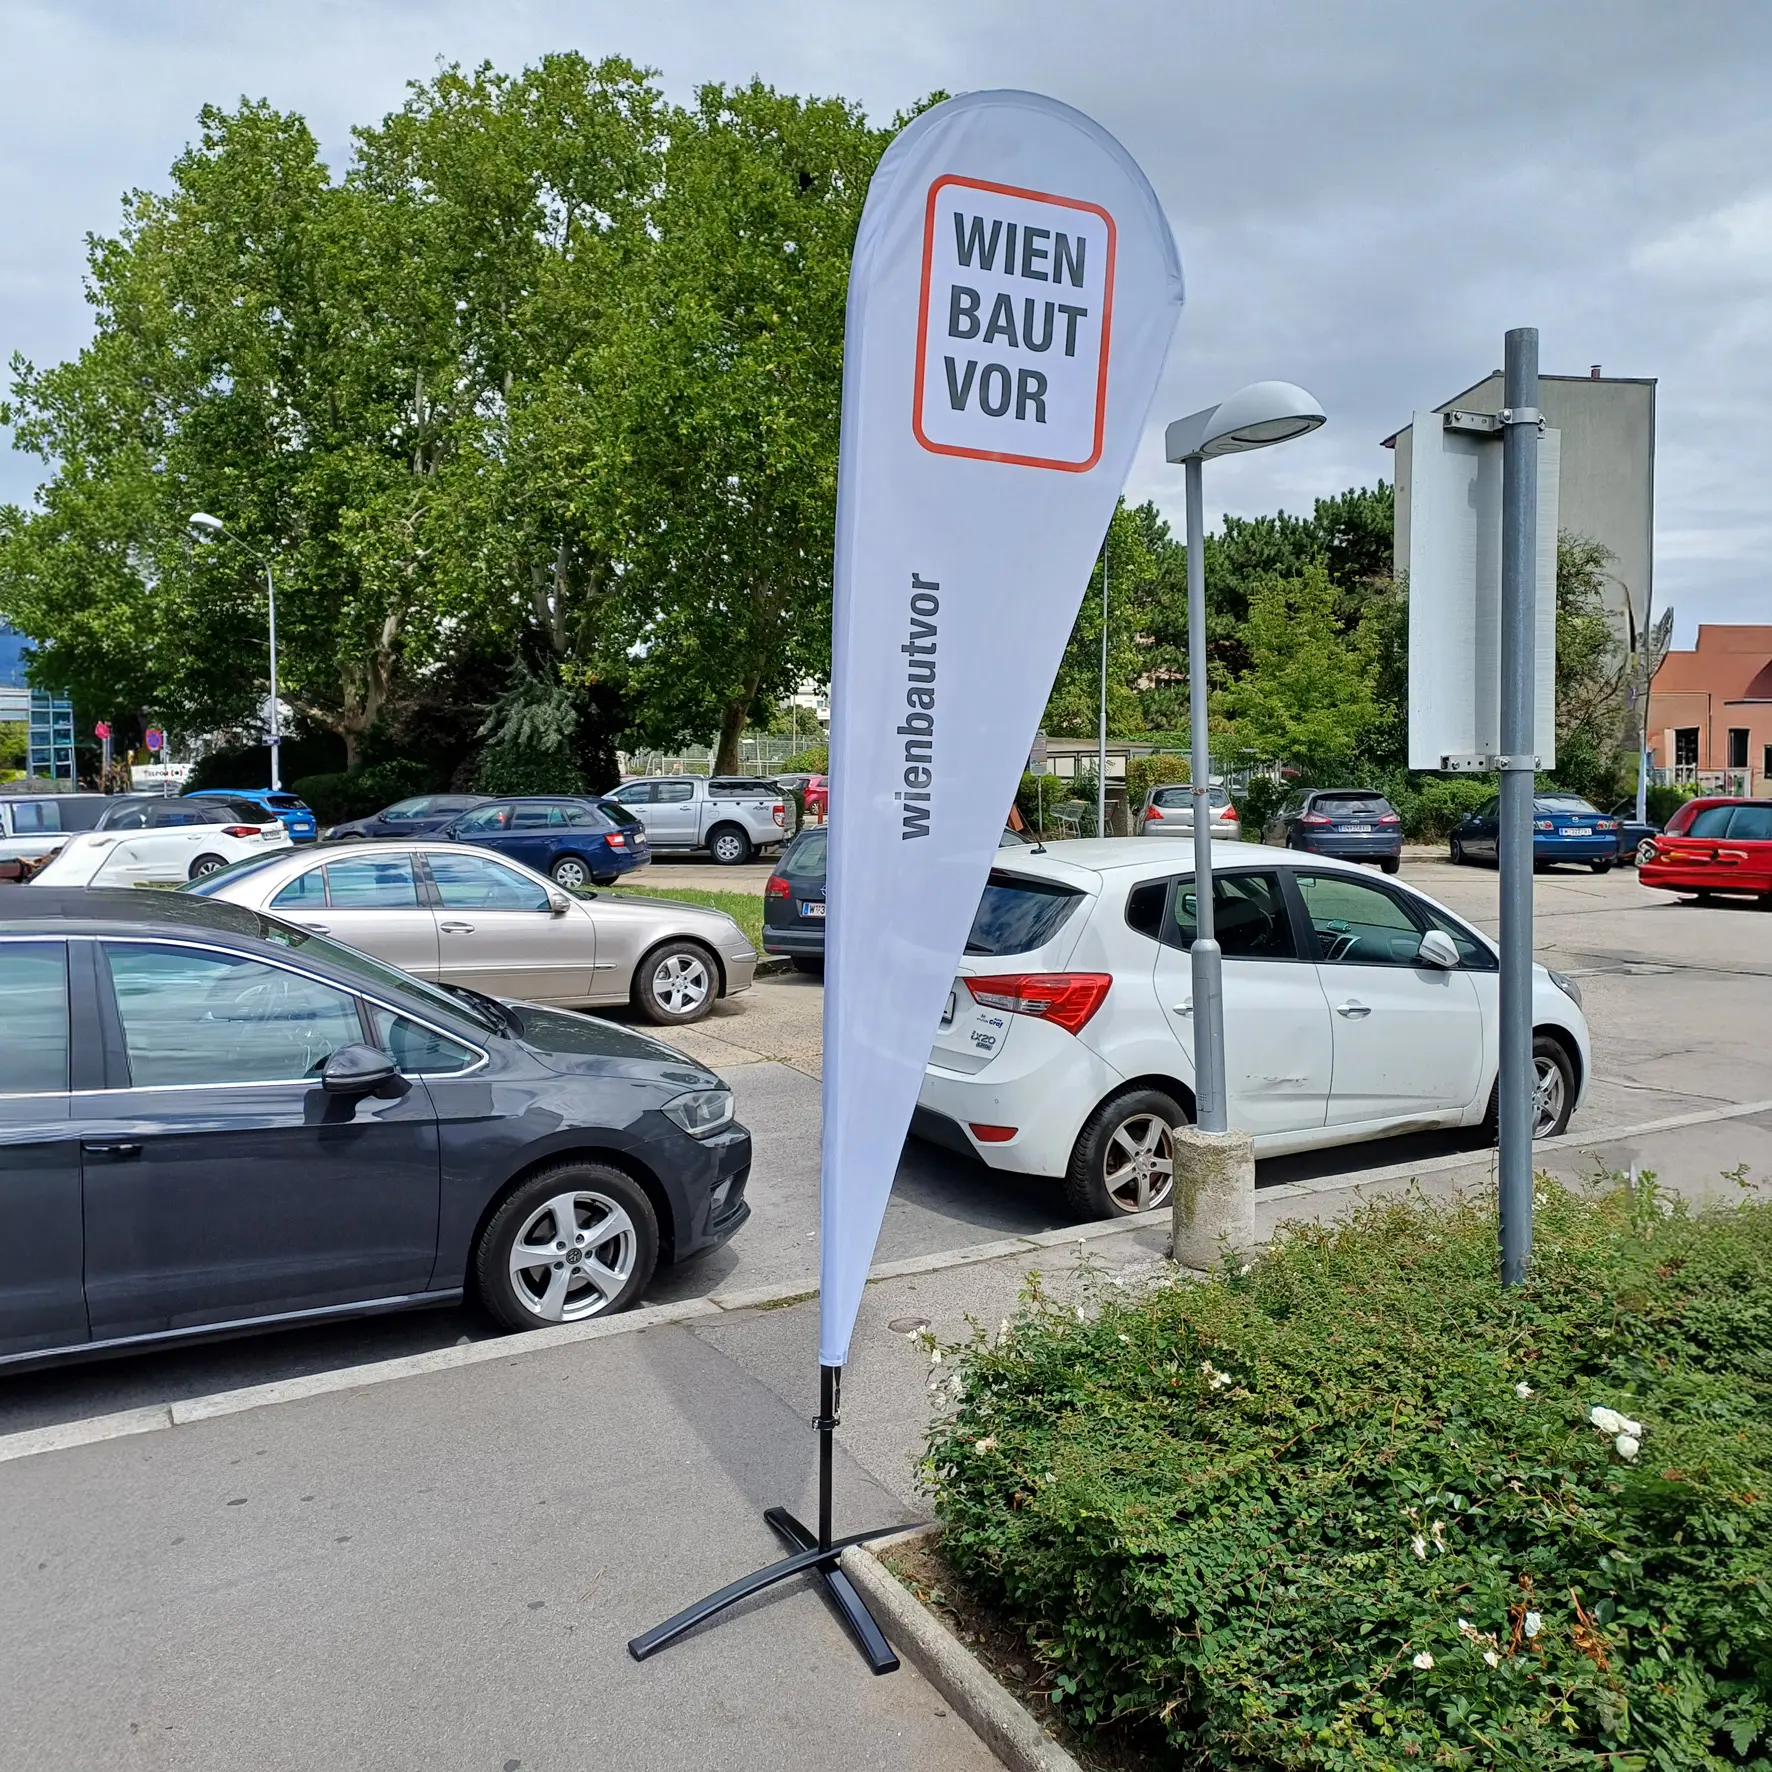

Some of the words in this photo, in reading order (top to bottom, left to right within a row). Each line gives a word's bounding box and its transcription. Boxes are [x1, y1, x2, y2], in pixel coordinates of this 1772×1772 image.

[953, 212, 1087, 289] WIEN
[948, 284, 1088, 358] BAUT
[943, 355, 1048, 424] VOR
[894, 572, 940, 841] wienbautvor
